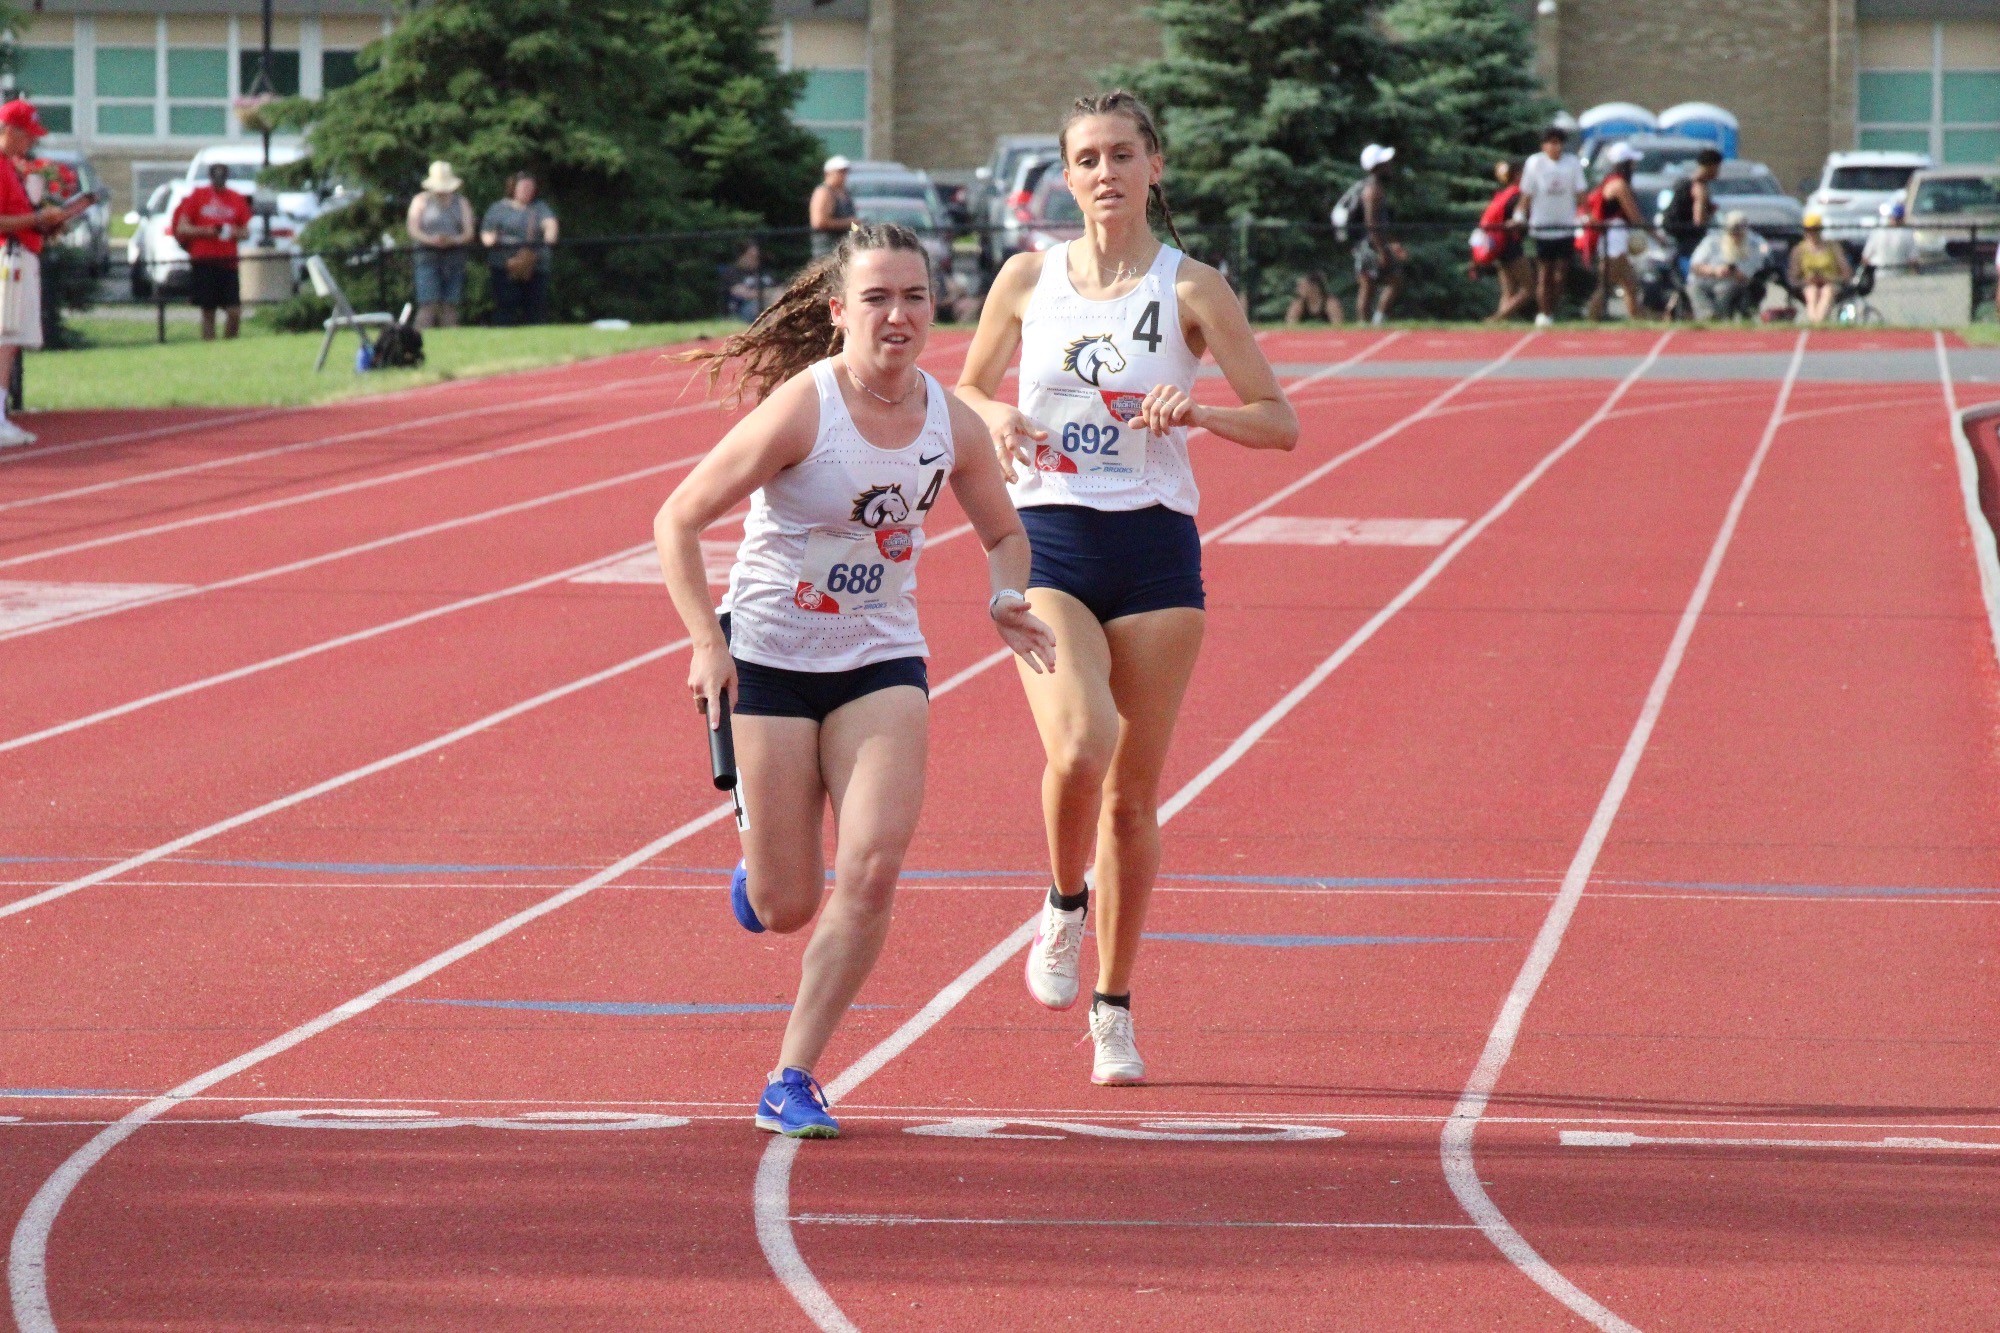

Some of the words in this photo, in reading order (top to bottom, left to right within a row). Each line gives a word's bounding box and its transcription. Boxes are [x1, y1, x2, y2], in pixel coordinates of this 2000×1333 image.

[1132, 300, 1162, 352] 4
[1062, 421, 1120, 456] 692
[1102, 465, 1134, 474] BROOKS
[916, 469, 945, 511] 4
[827, 563, 885, 594] 688
